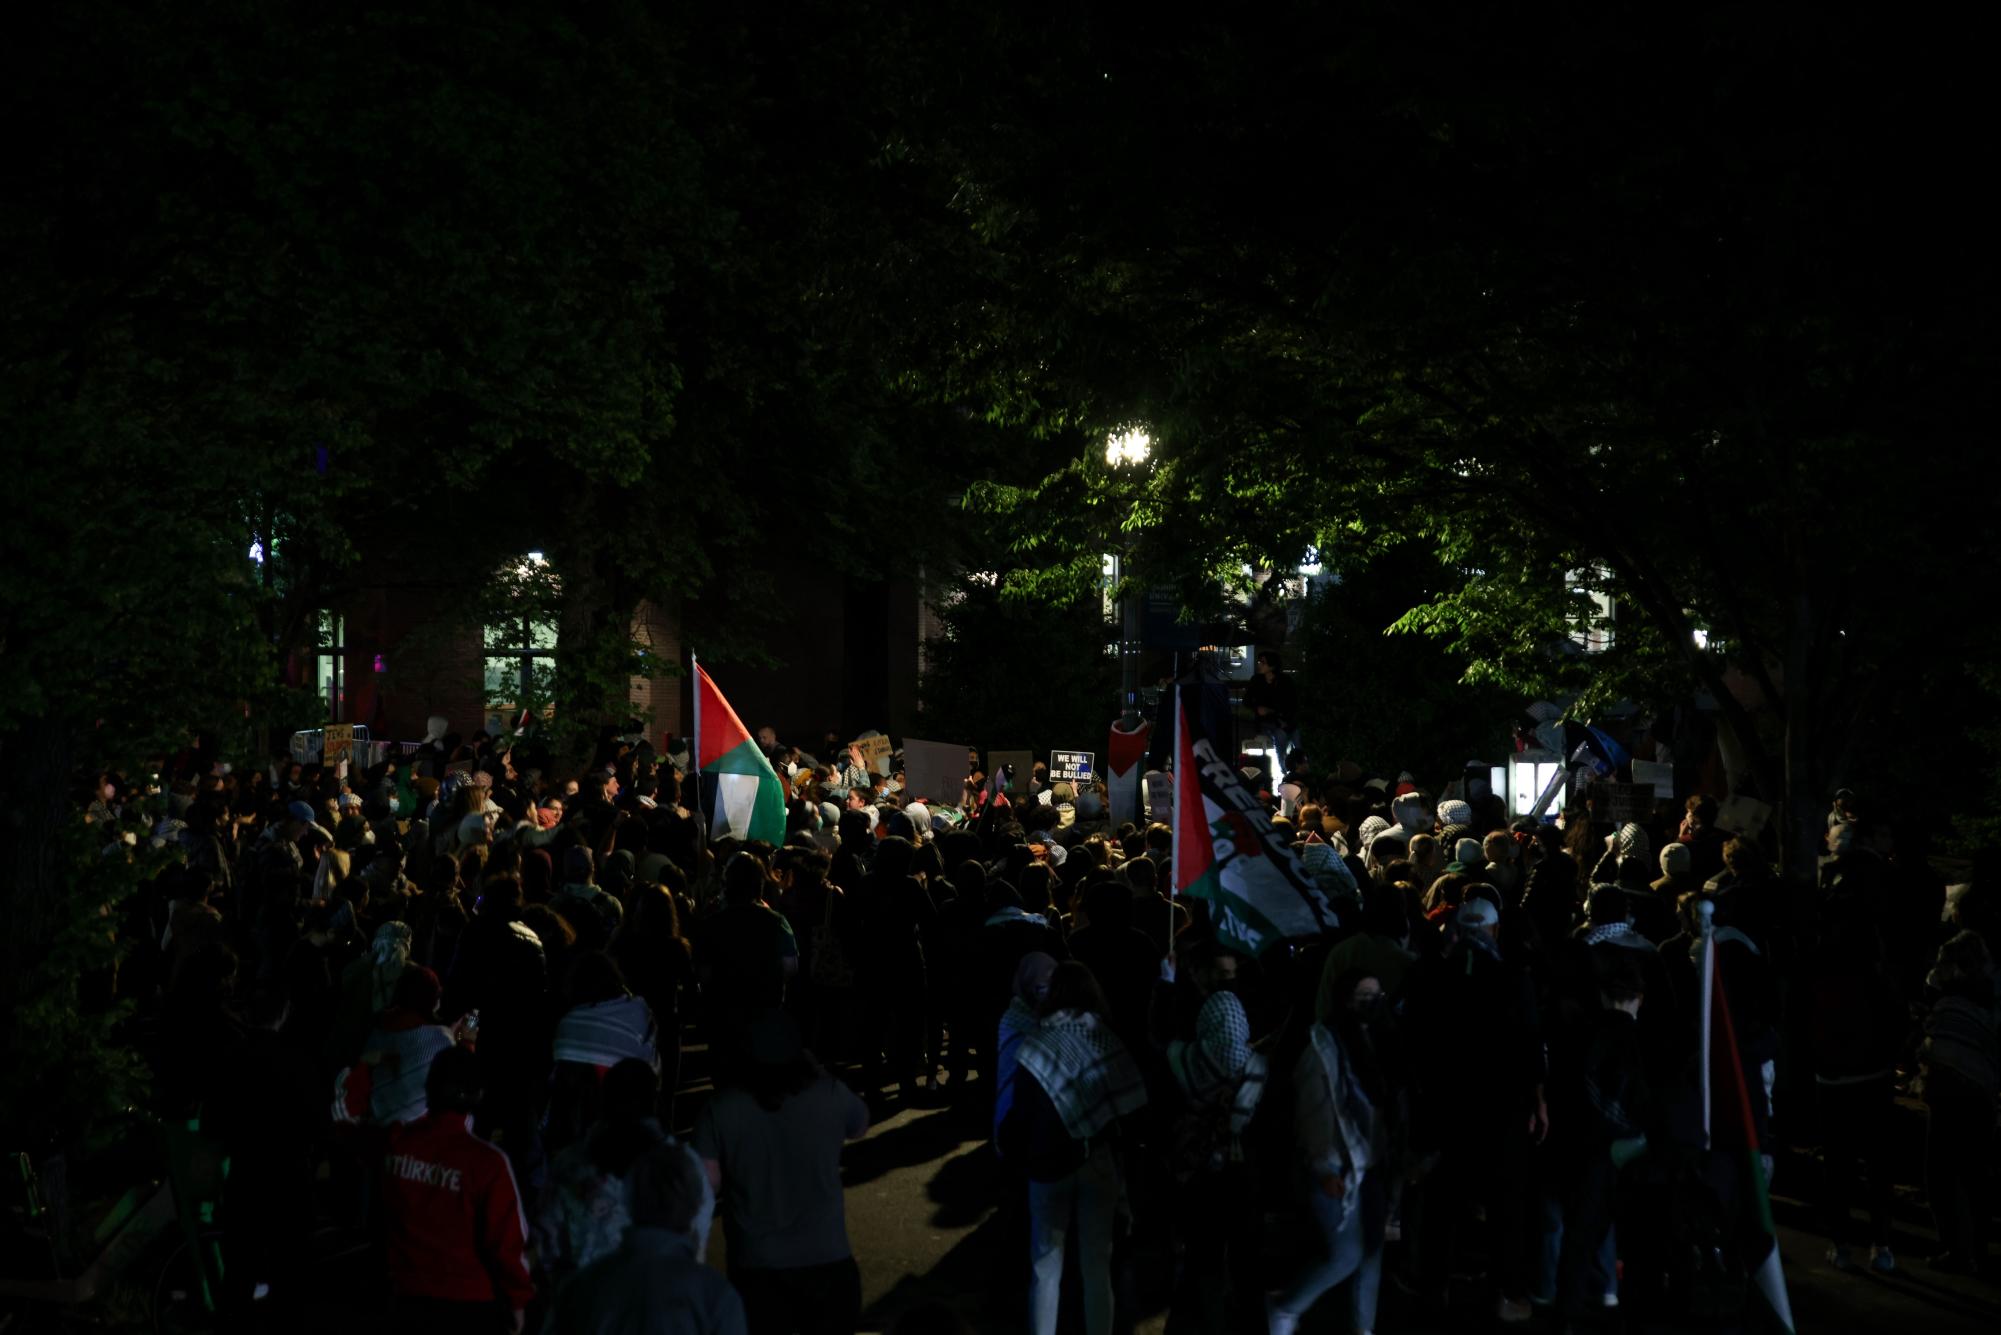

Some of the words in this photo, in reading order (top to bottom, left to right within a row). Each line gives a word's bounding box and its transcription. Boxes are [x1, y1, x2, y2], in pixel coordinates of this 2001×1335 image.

[1057, 754, 1070, 762] WE
[1071, 755, 1088, 763] WILL
[1065, 763, 1081, 771] NOT
[1050, 769, 1061, 778] BE
[1062, 770, 1092, 779] BULLIED
[1192, 738, 1341, 928] FREEDOM
